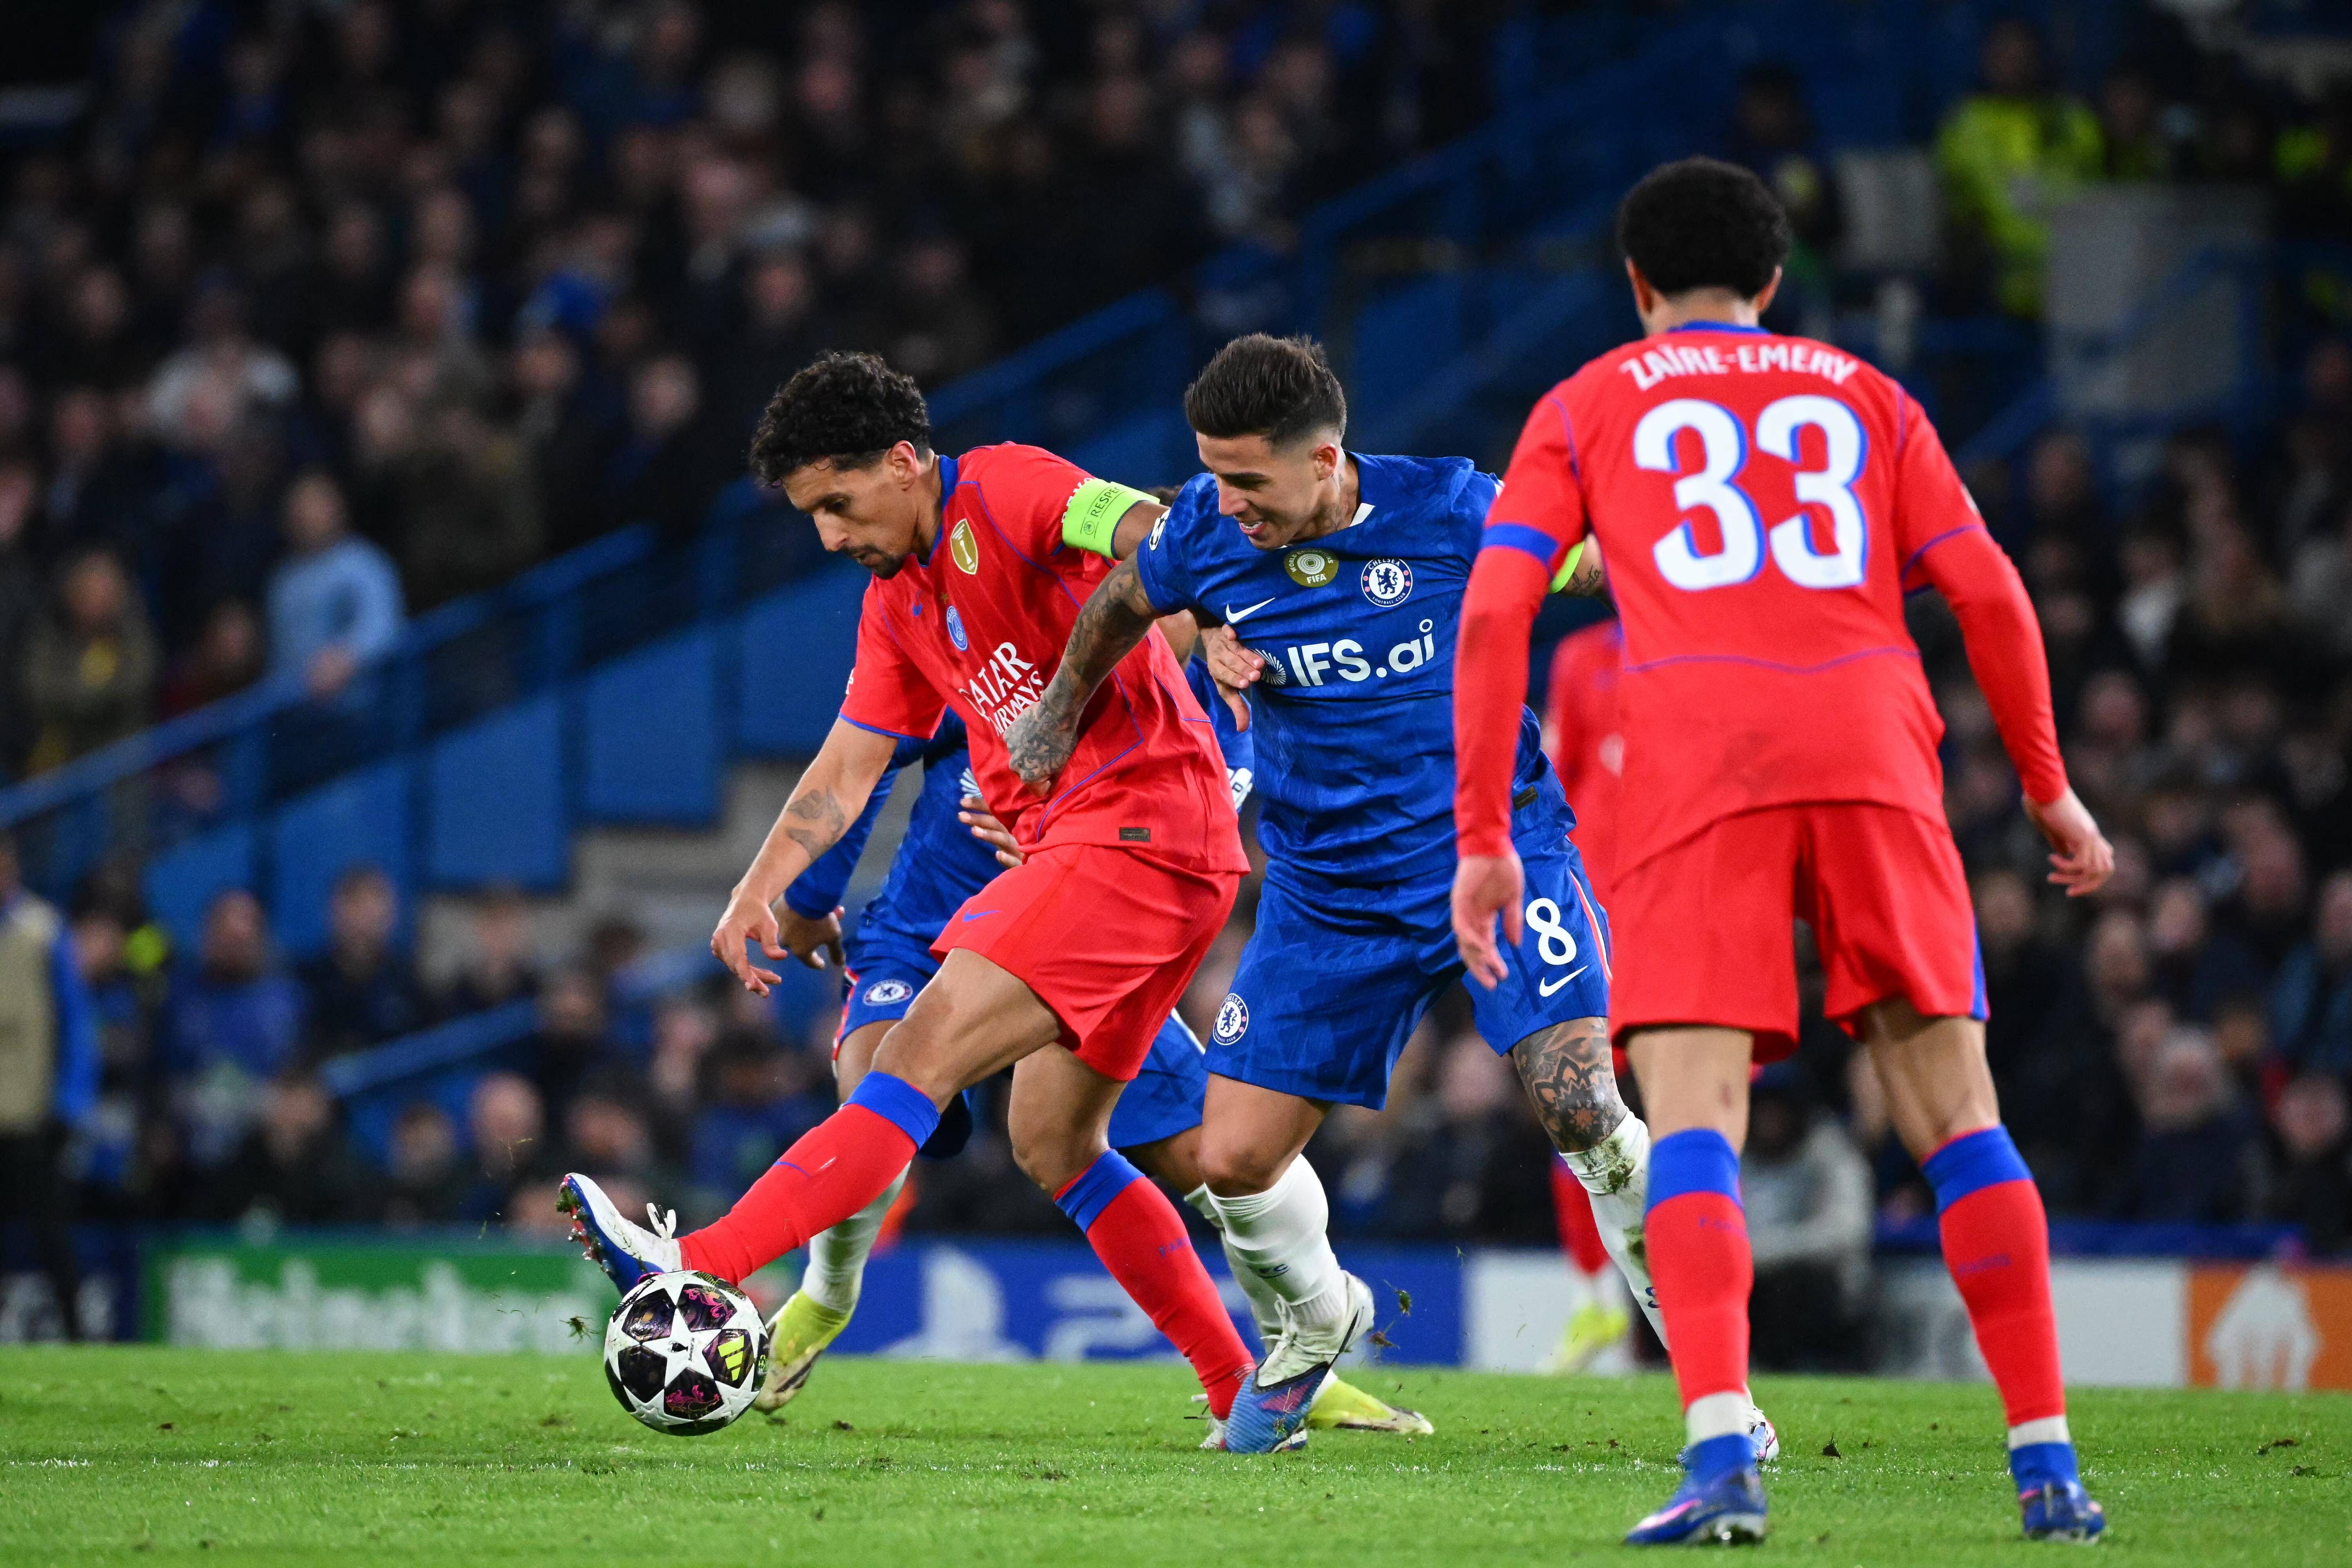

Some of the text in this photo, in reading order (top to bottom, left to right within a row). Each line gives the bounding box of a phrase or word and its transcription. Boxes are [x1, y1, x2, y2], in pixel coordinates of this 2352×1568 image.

[1619, 343, 1858, 391] ZAÏRE-EMERY
[1633, 394, 1868, 592] 33
[1289, 554, 1297, 572] WORLD
[1307, 573, 1327, 584] FIFA
[1368, 559, 1400, 570] CHELSEA
[1372, 592, 1405, 604] FOOTBALL CLUB
[1288, 619, 1434, 687] IFS.ai
[1525, 898, 1577, 965] 8
